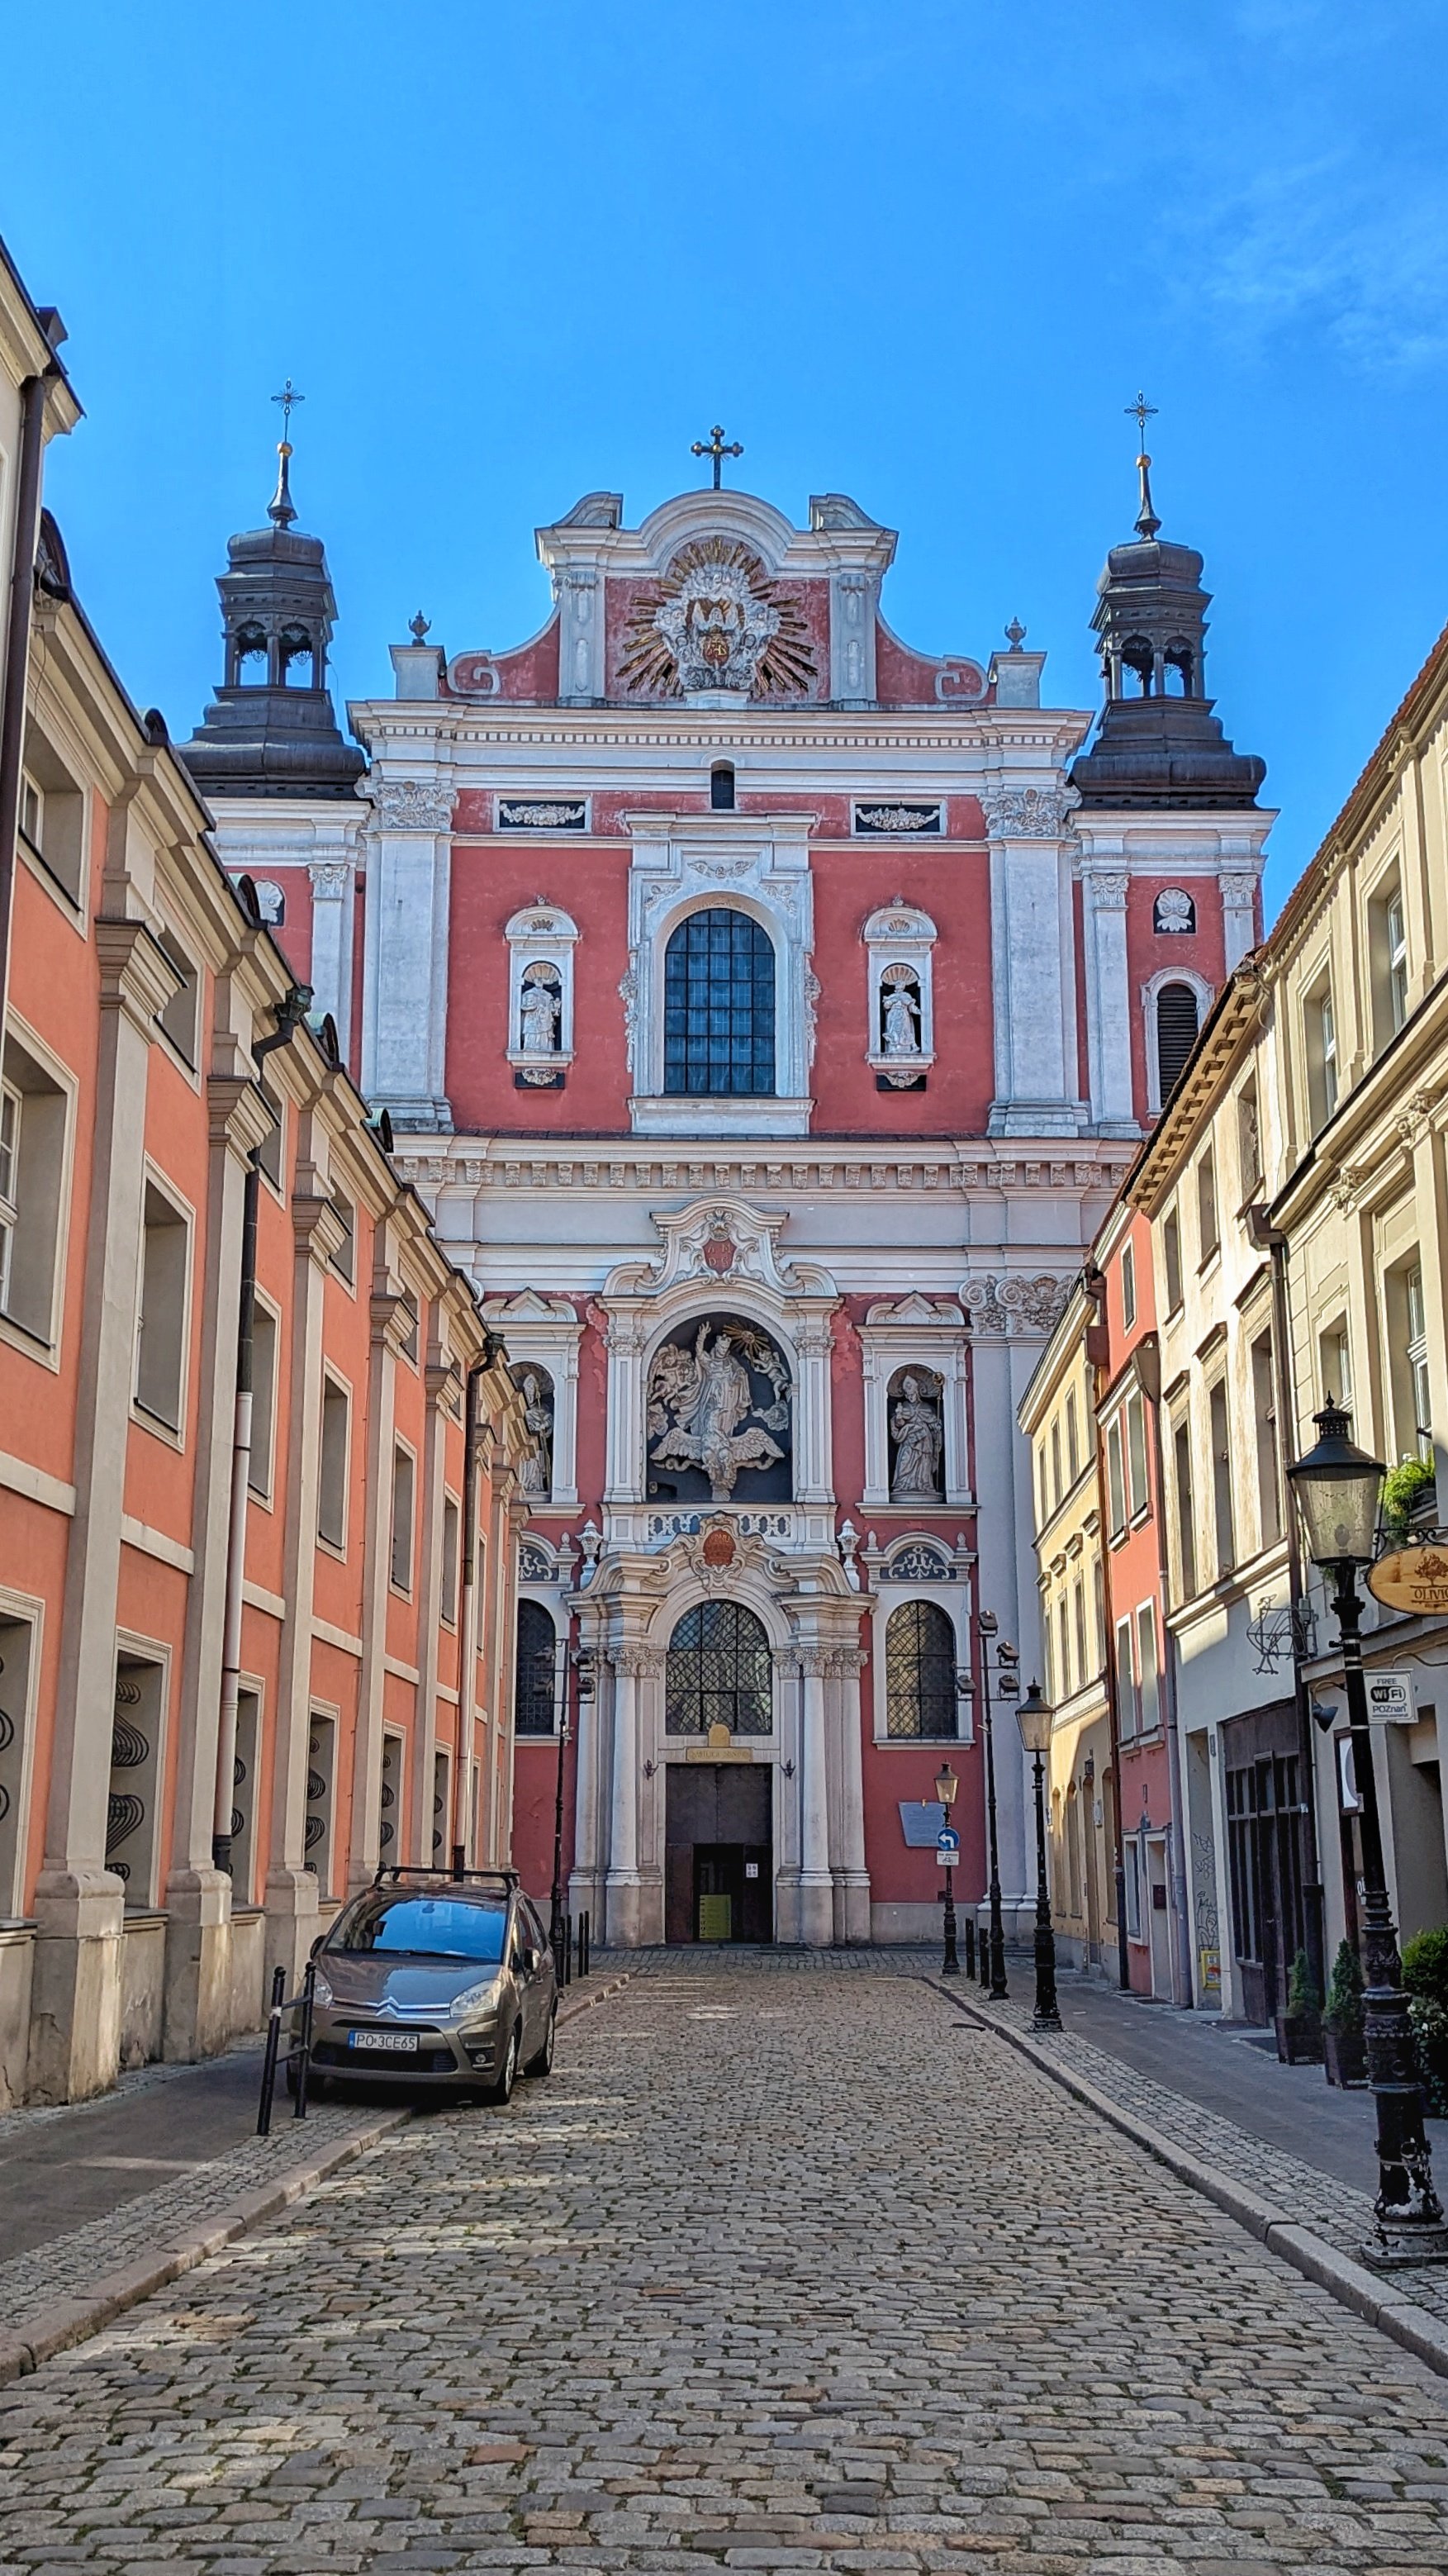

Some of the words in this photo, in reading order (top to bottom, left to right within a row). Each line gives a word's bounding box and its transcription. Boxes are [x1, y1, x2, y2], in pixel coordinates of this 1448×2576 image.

[1373, 1688, 1403, 1699] WiFi
[356, 2034, 374, 2047] PO
[377, 2035, 415, 2050] 3CE65
